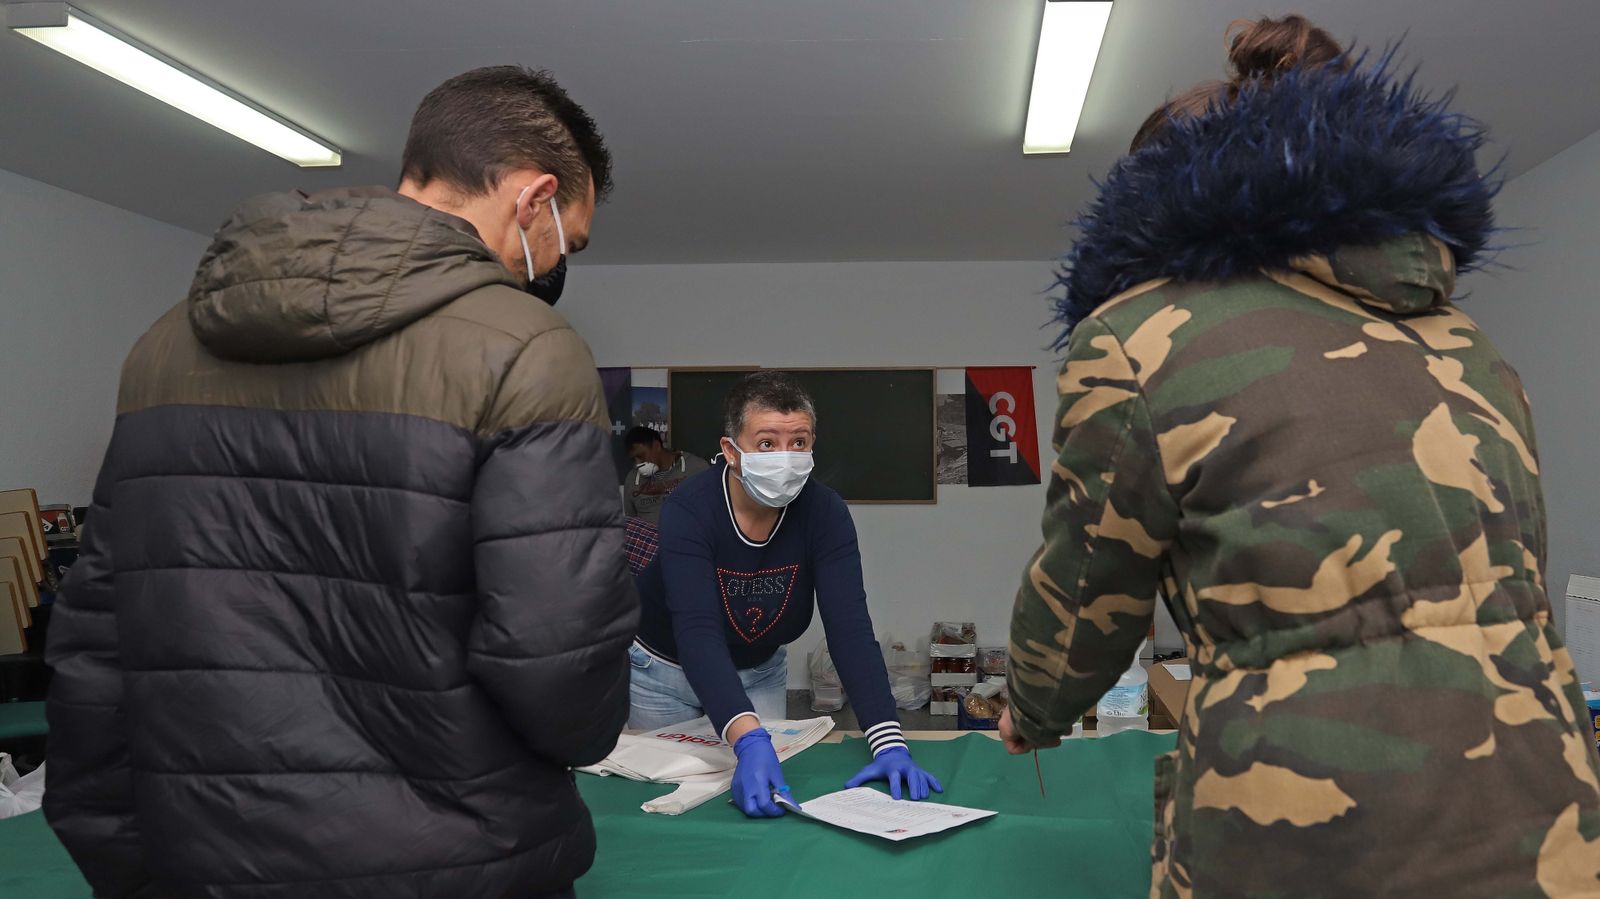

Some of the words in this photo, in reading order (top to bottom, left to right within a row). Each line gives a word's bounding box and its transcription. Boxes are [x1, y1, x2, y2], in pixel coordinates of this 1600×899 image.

[989, 391, 1018, 464] CGT
[726, 575, 785, 597] GUESS
[744, 606, 765, 634] ?
